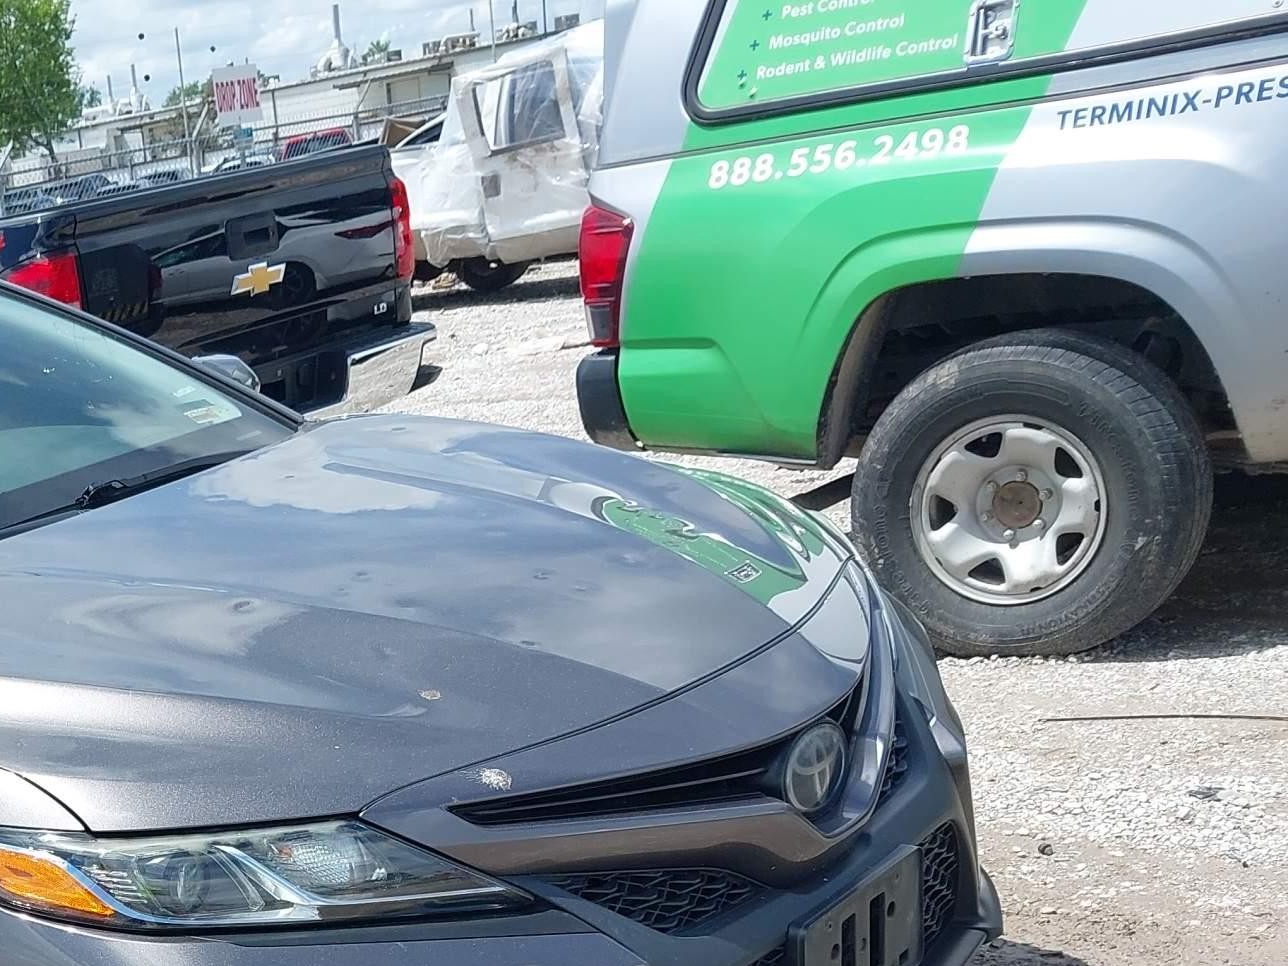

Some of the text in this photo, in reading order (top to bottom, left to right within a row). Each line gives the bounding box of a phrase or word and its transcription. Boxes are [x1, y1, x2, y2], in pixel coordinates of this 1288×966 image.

[781, 0, 875, 19] Pest Contr
[768, 13, 905, 50] Mosquito Control
[756, 33, 959, 80] Rodent & Wildlife Control
[215, 77, 260, 113] DROP ZONE
[707, 124, 970, 190] 888.556.2498
[374, 302, 387, 316] LD
